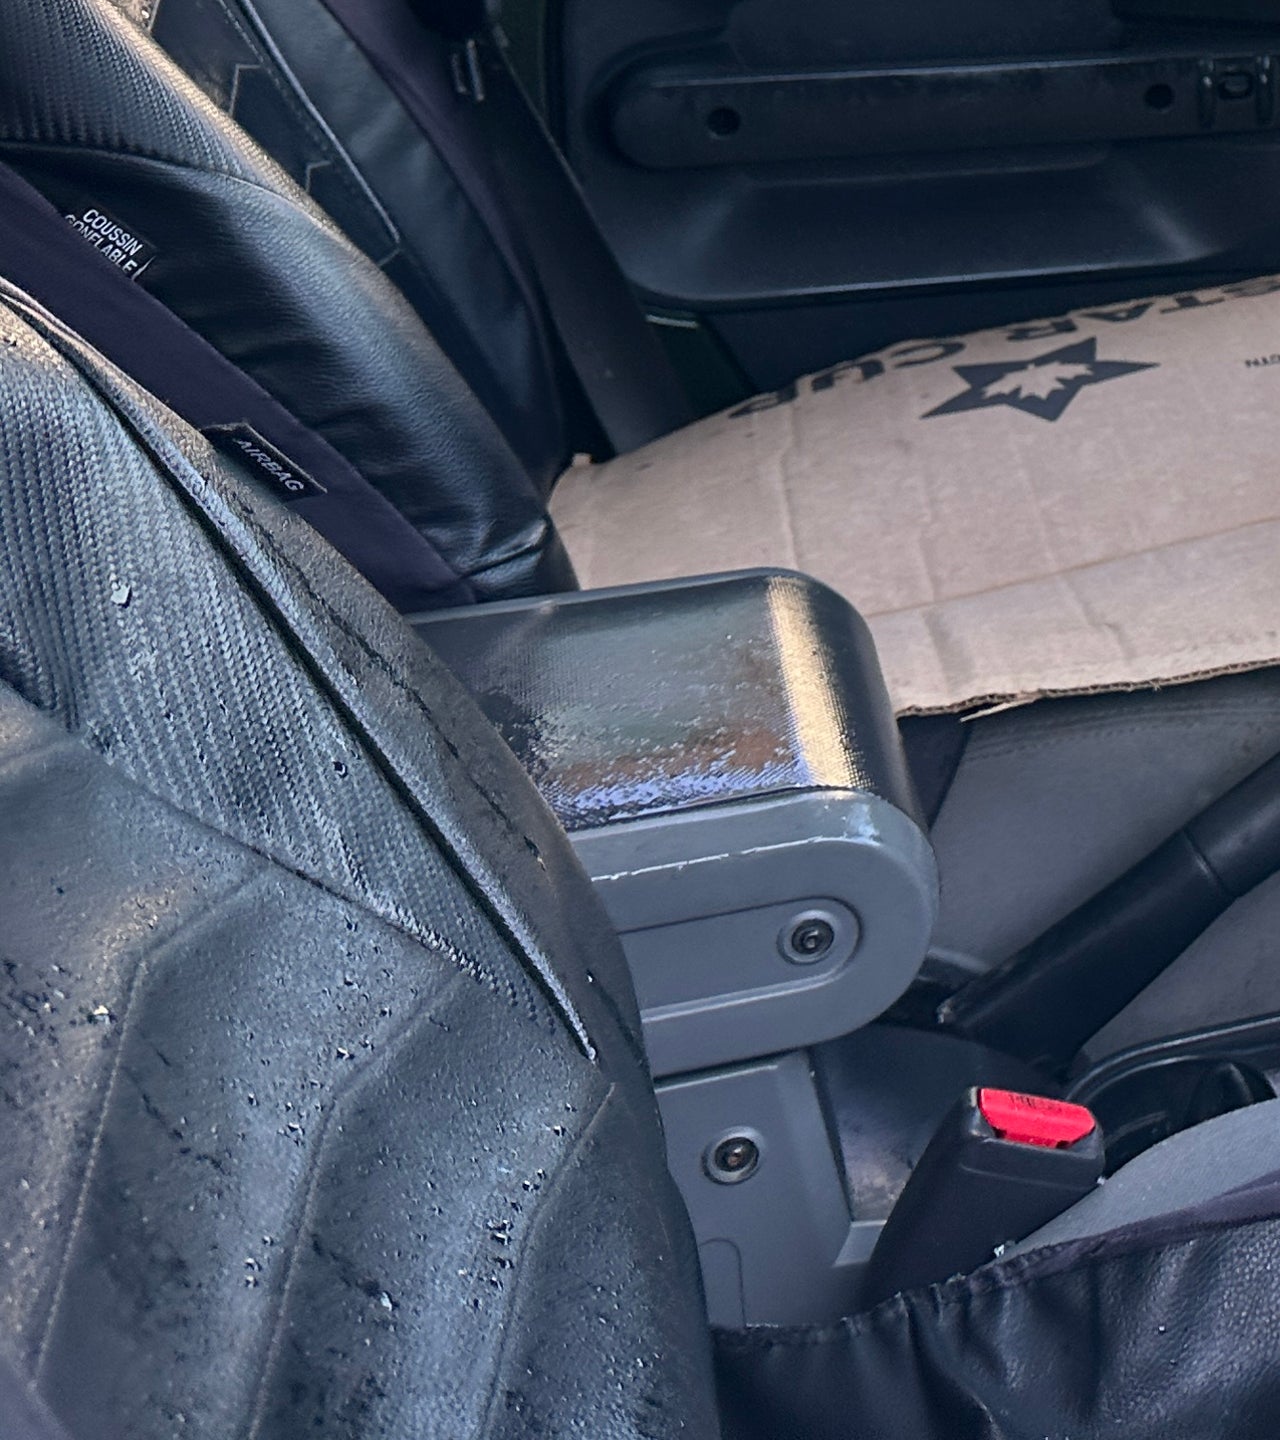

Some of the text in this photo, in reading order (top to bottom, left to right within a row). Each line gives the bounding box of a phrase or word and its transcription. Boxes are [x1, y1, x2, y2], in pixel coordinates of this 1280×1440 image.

[82, 207, 144, 257] COUSSIN
[727, 338, 969, 418] CUP
[235, 438, 306, 493] AIRBAG
